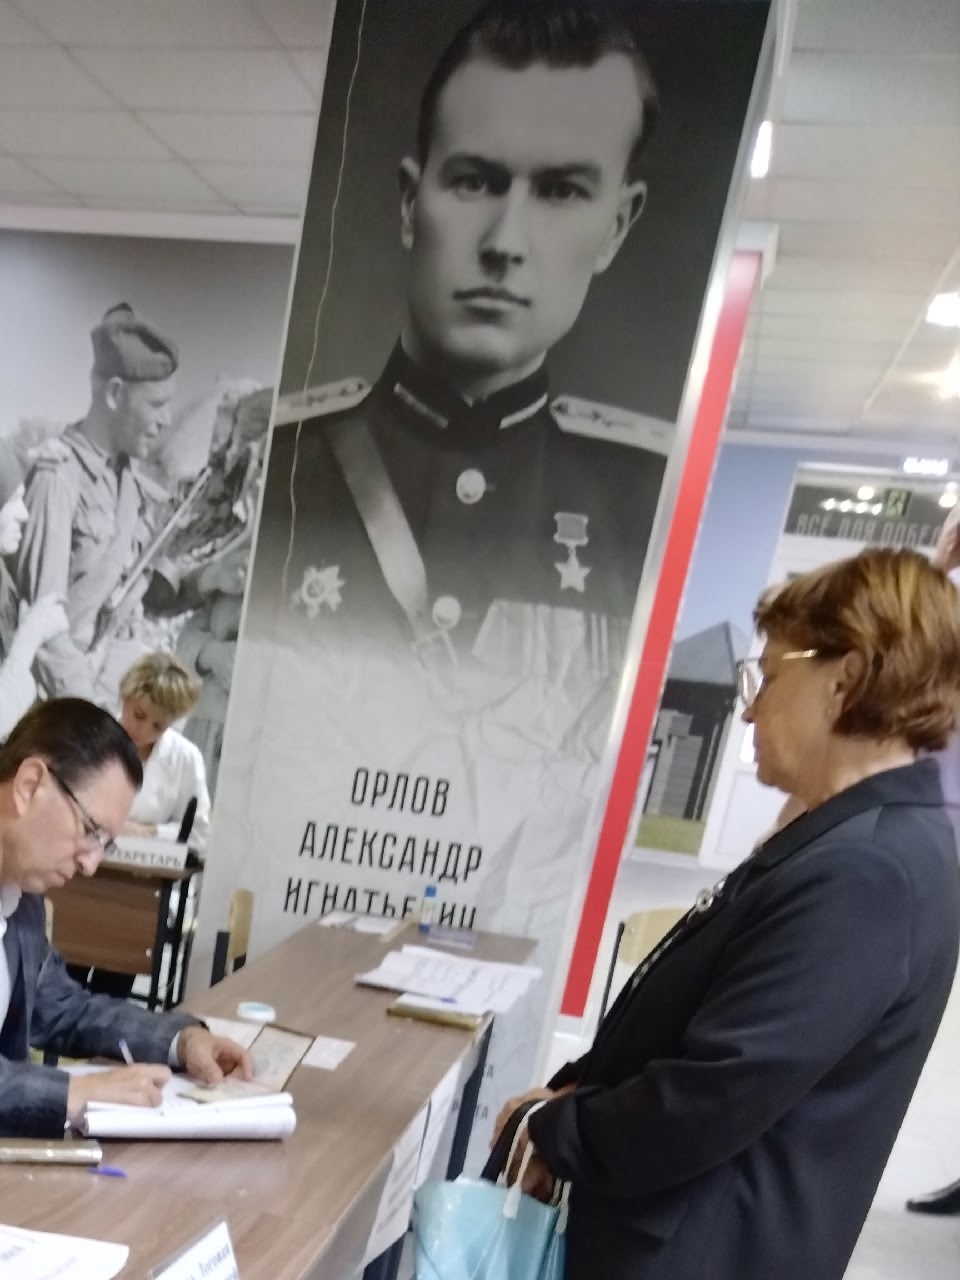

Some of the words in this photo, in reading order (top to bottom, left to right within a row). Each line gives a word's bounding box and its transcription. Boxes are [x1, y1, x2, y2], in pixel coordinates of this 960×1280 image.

[350, 767, 450, 817] ОРЛОВ
[298, 821, 483, 885] АЛЕКСАНДР
[284, 877, 477, 931] ИГНАТЬЕИЧ
